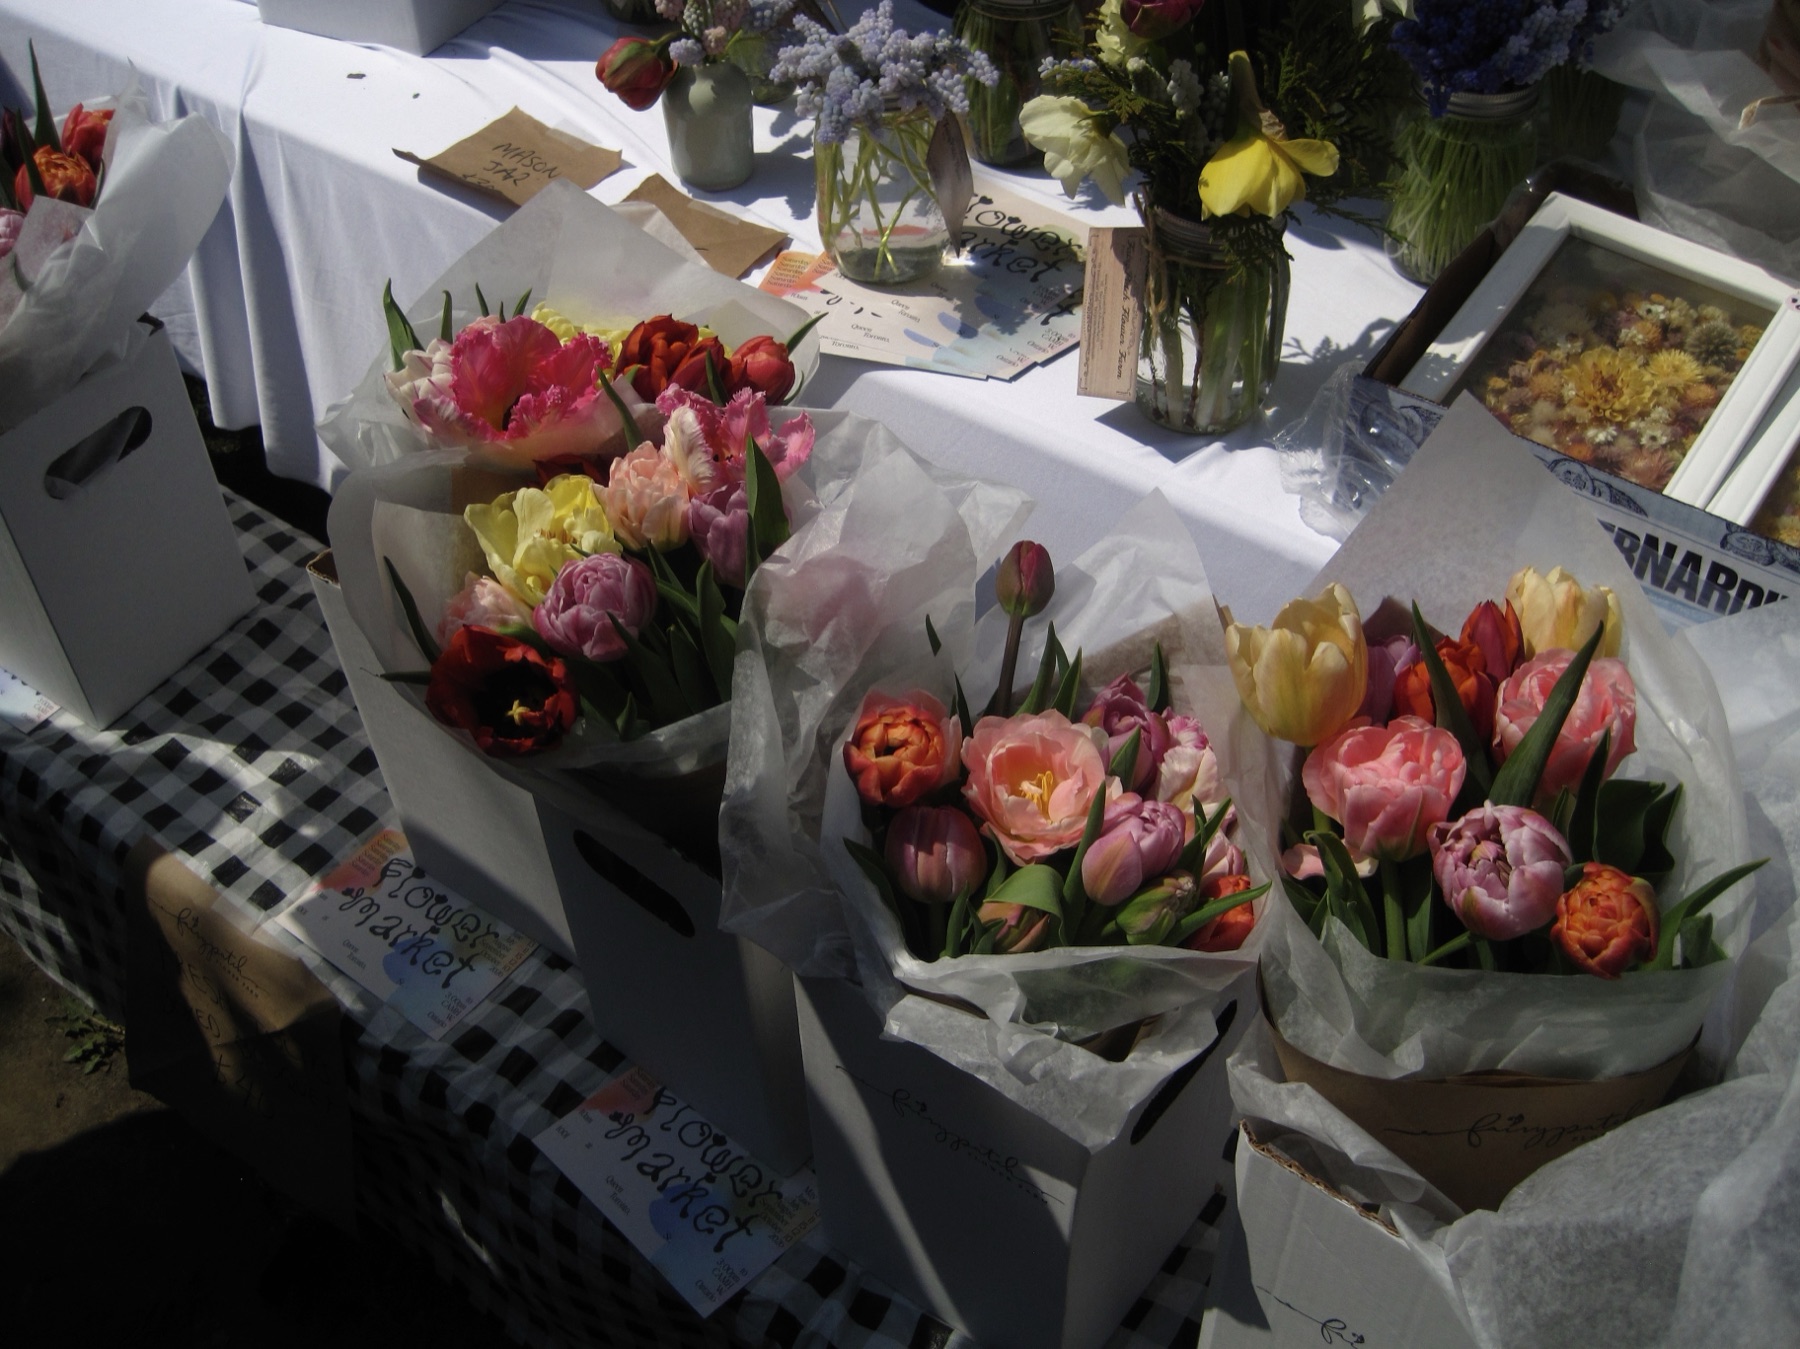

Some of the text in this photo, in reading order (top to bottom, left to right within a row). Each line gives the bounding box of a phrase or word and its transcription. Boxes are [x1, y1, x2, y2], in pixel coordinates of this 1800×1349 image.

[483, 160, 529, 187] JAR
[492, 142, 562, 179] MASON
[964, 195, 1083, 257] lower
[959, 230, 1062, 283] arket
[851, 323, 873, 333] Queen
[1119, 305, 1131, 347] Flower
[996, 354, 1019, 367] Ontario
[1026, 340, 1049, 354] Ontario
[1116, 350, 1127, 381] Farm
[1597, 517, 1789, 617] RNARD
[604, 1174, 624, 1194] Queen
[710, 1266, 733, 1290] CAMH
